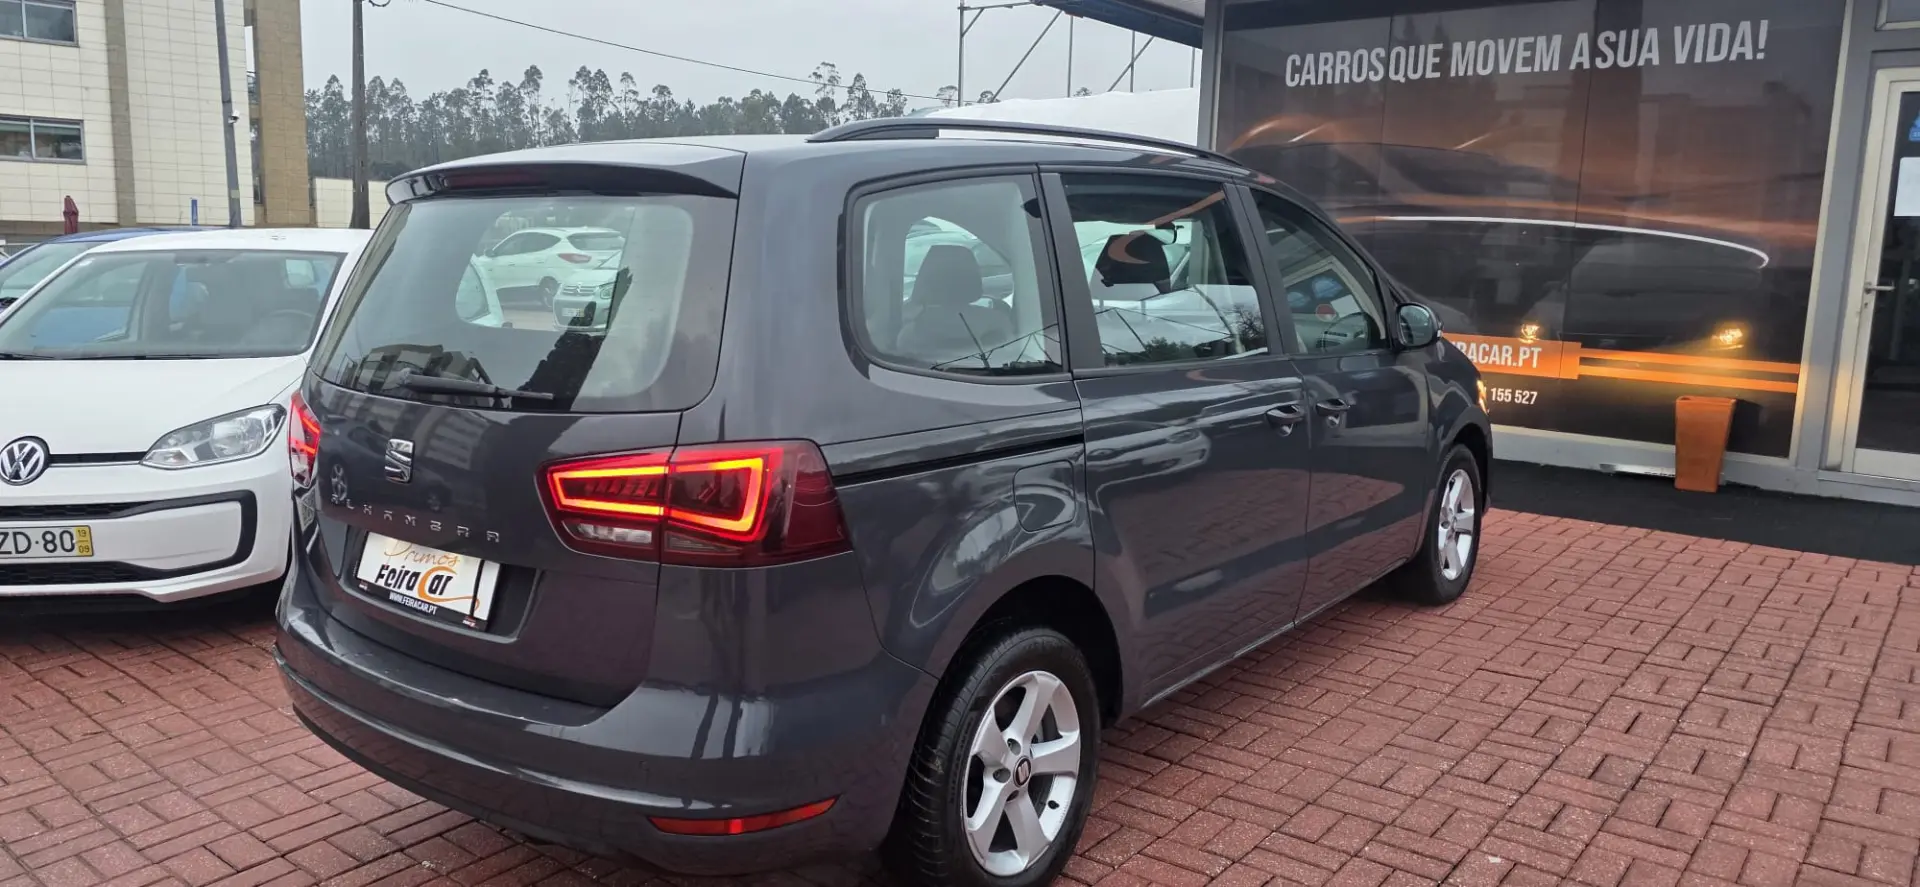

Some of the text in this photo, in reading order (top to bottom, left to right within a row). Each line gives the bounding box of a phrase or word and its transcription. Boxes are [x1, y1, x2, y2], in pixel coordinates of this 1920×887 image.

[1285, 19, 1770, 88] CARROS QUE MOVEM A SUA VIDA!
[1452, 341, 1542, 369] RACAR.PT
[1490, 387, 1512, 403] 155
[1514, 389, 1538, 405] 527
[388, 591, 438, 616] WWW.FEIRACAR.PT
